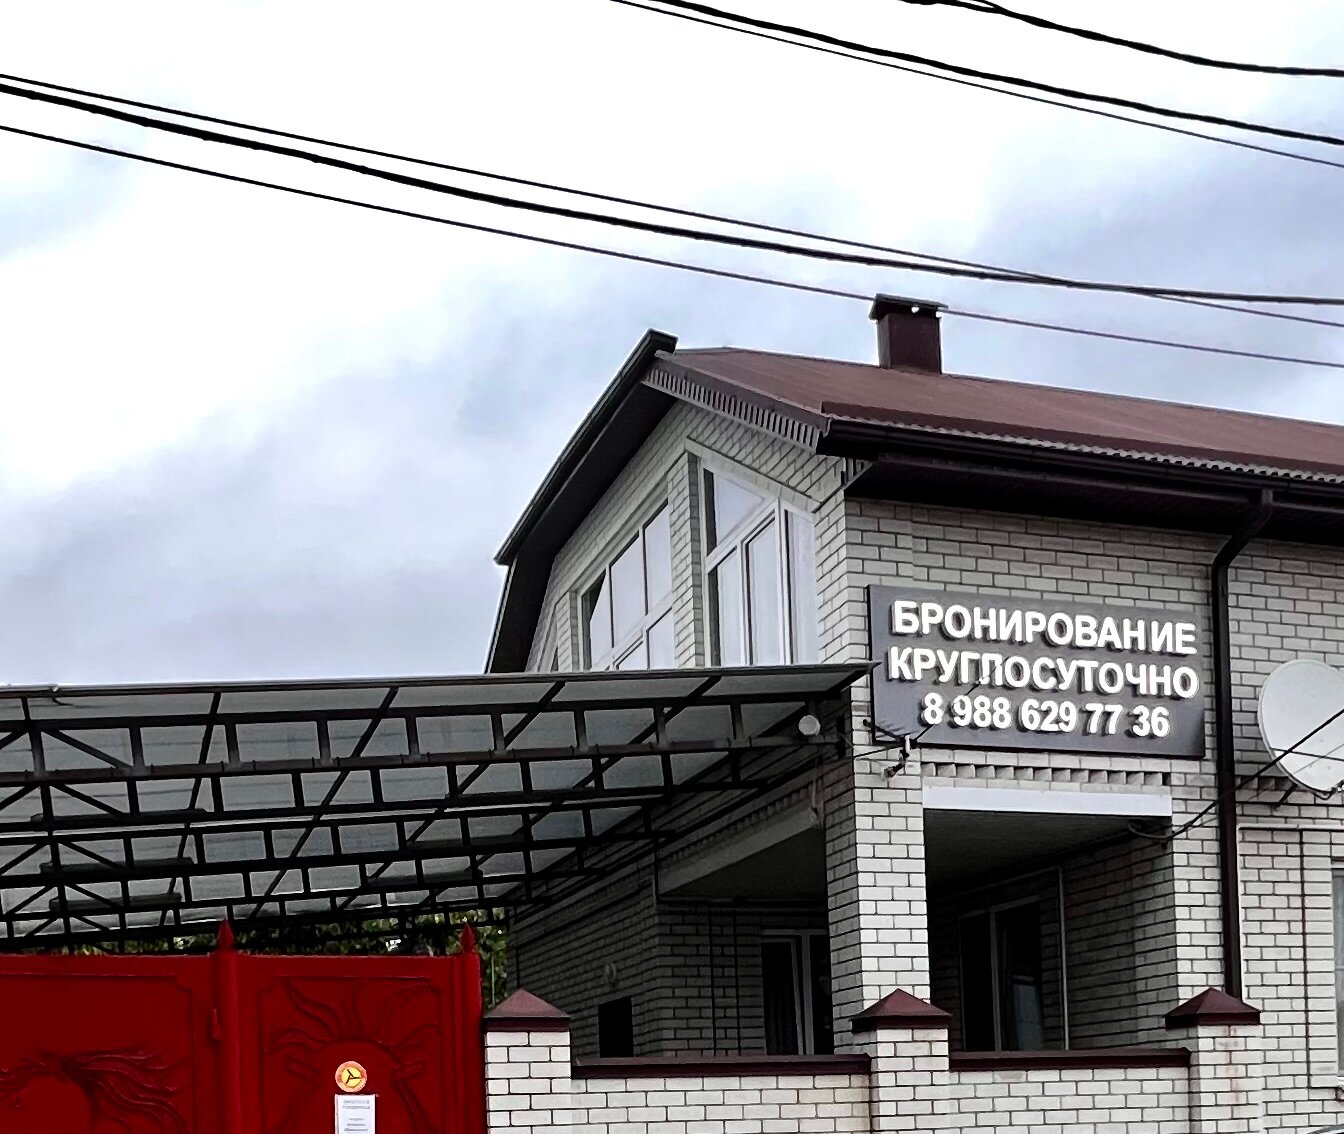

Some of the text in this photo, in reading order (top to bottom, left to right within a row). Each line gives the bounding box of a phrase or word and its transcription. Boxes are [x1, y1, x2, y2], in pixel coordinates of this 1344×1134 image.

[891, 600, 1198, 654] БРОНИРОВАНИЕ
[887, 646, 1199, 698] КРУГЛОСУТОЧНО
[922, 693, 1171, 738] 8 988 629 77 36
